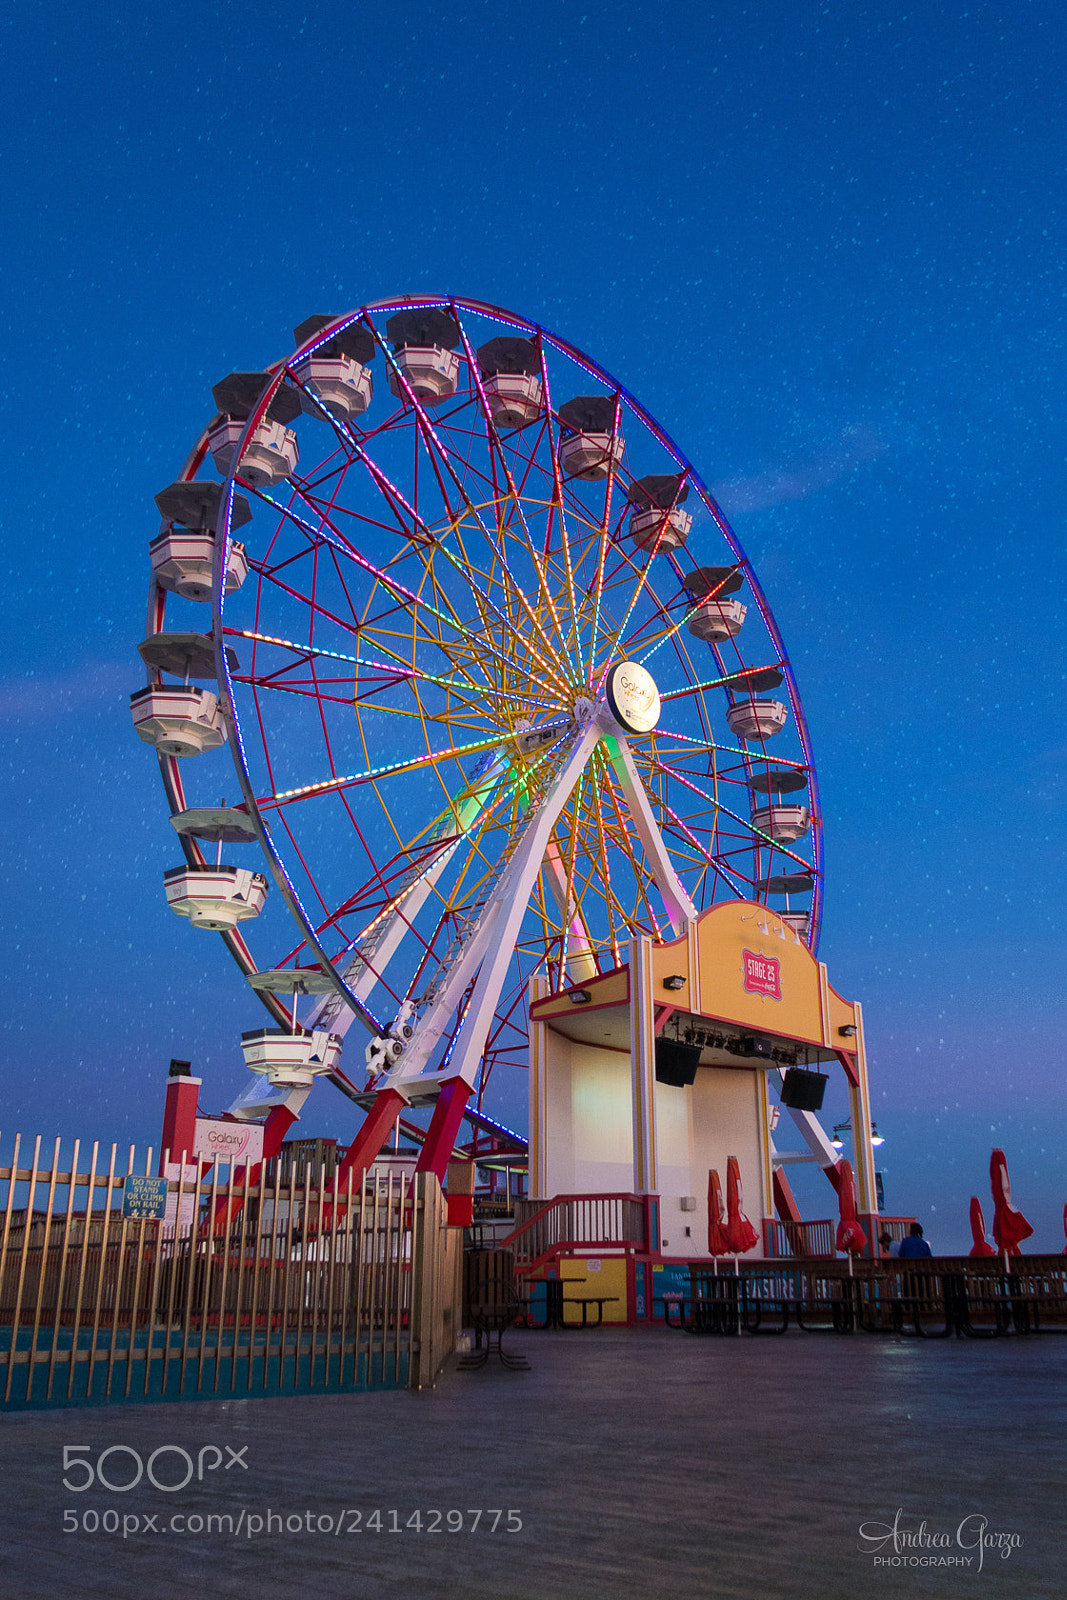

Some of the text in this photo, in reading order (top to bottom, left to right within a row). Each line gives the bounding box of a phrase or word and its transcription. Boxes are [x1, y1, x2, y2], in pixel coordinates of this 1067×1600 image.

[255, 873, 262, 881] 5
[748, 959, 766, 980] STAGE
[208, 1131, 243, 1148] Galaxy
[132, 1178, 162, 1187] DO NOT
[133, 1186, 159, 1194] STAND
[127, 1192, 164, 1202] OR CLIMB
[129, 1200, 160, 1209] ON RAIL
